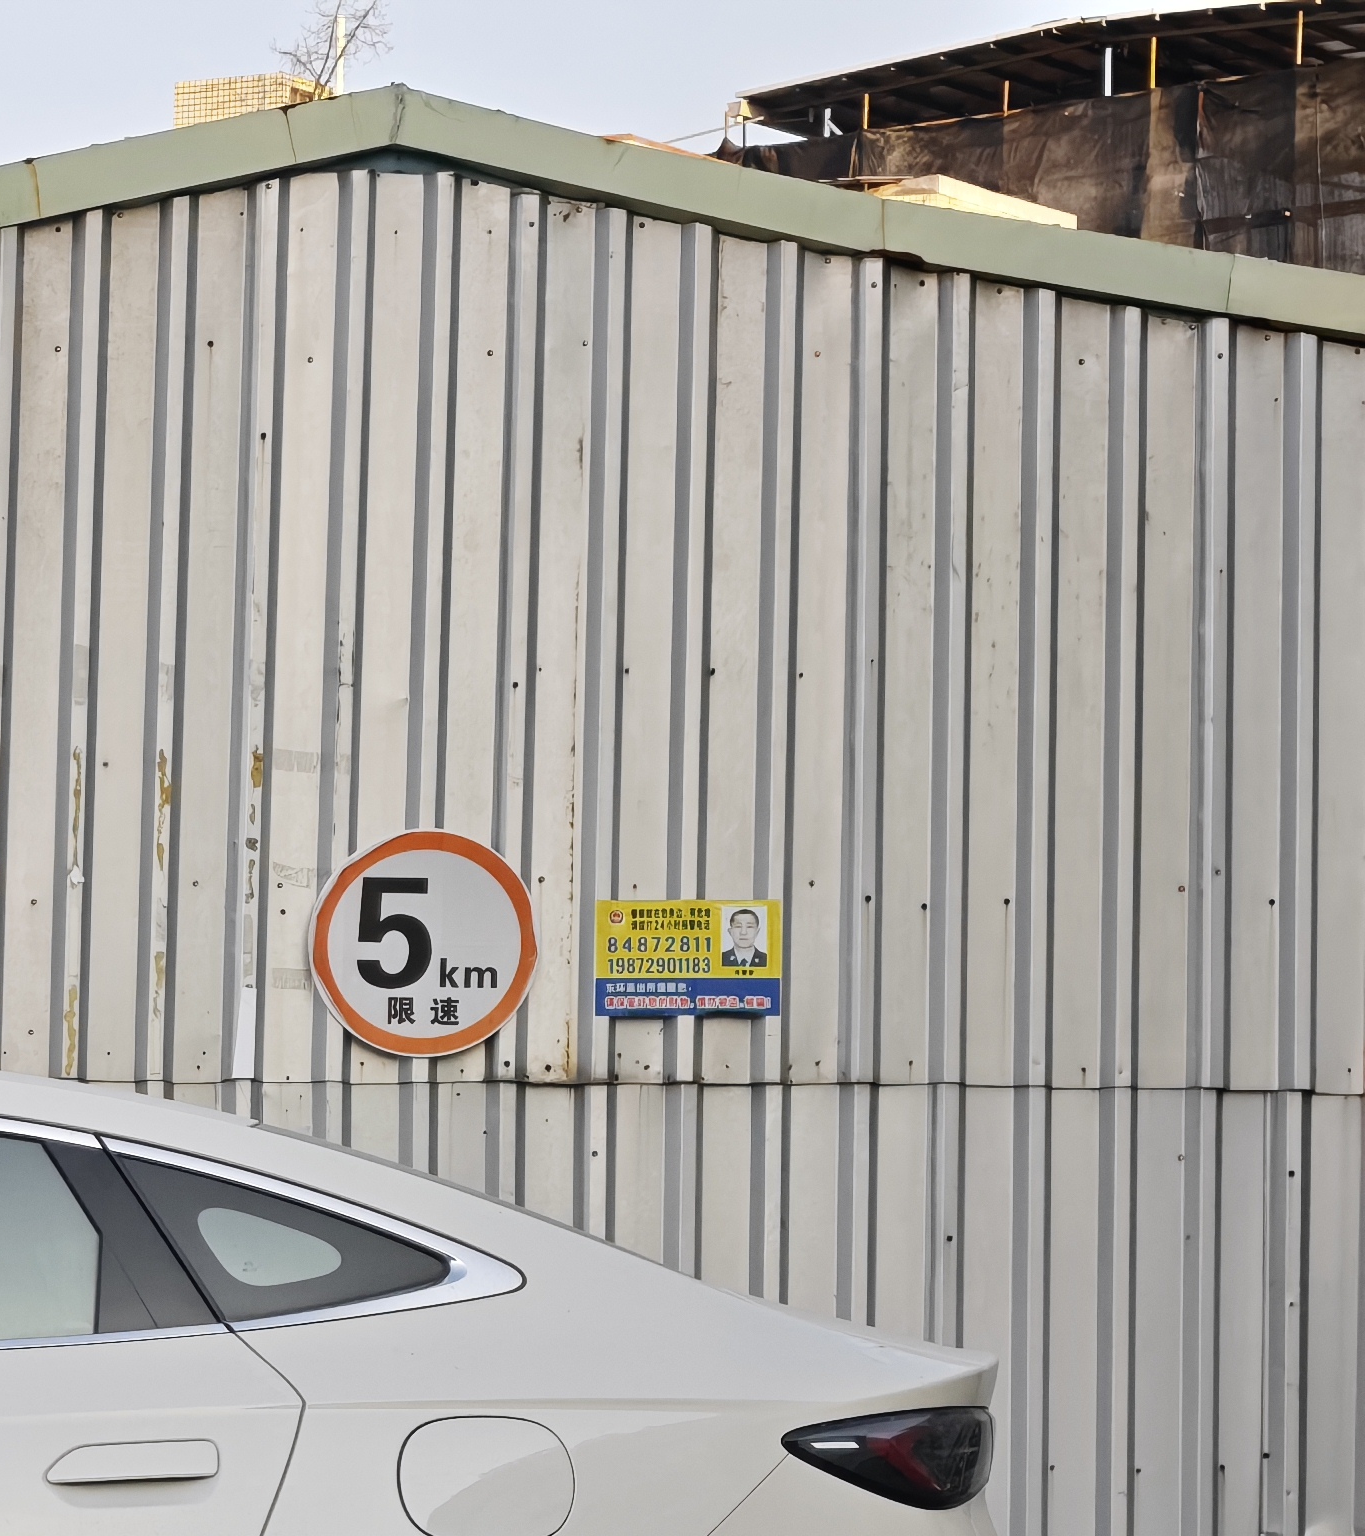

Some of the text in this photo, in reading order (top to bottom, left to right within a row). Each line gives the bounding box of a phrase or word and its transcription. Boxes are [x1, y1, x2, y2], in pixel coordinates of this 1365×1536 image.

[357, 877, 498, 989] 5 km
[607, 936, 712, 953] 84872811
[607, 957, 712, 975] 19872901183
[387, 997, 460, 1026] 限速
